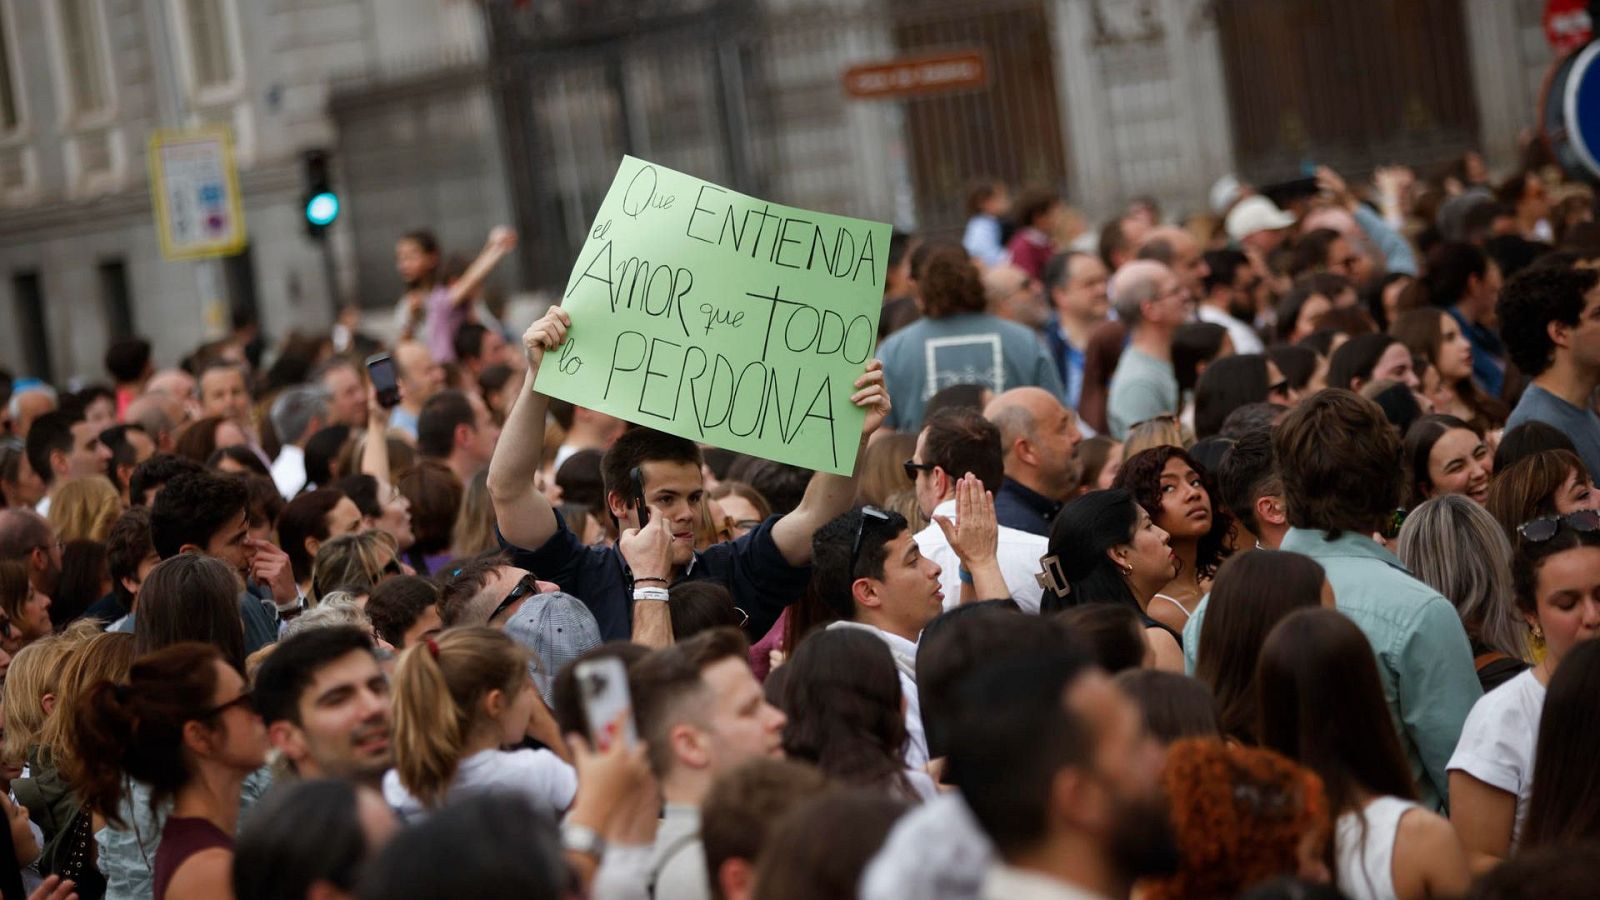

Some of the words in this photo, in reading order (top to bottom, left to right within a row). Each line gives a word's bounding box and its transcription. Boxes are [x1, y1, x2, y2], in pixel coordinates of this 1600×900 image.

[592, 219, 612, 240] el
[622, 165, 676, 220] Que
[686, 185, 876, 286] ENTIENDA
[566, 240, 693, 337] AMOR
[699, 303, 745, 336] que
[746, 285, 873, 365] TODO
[558, 337, 584, 376] lo
[603, 330, 838, 468] PERDONA
